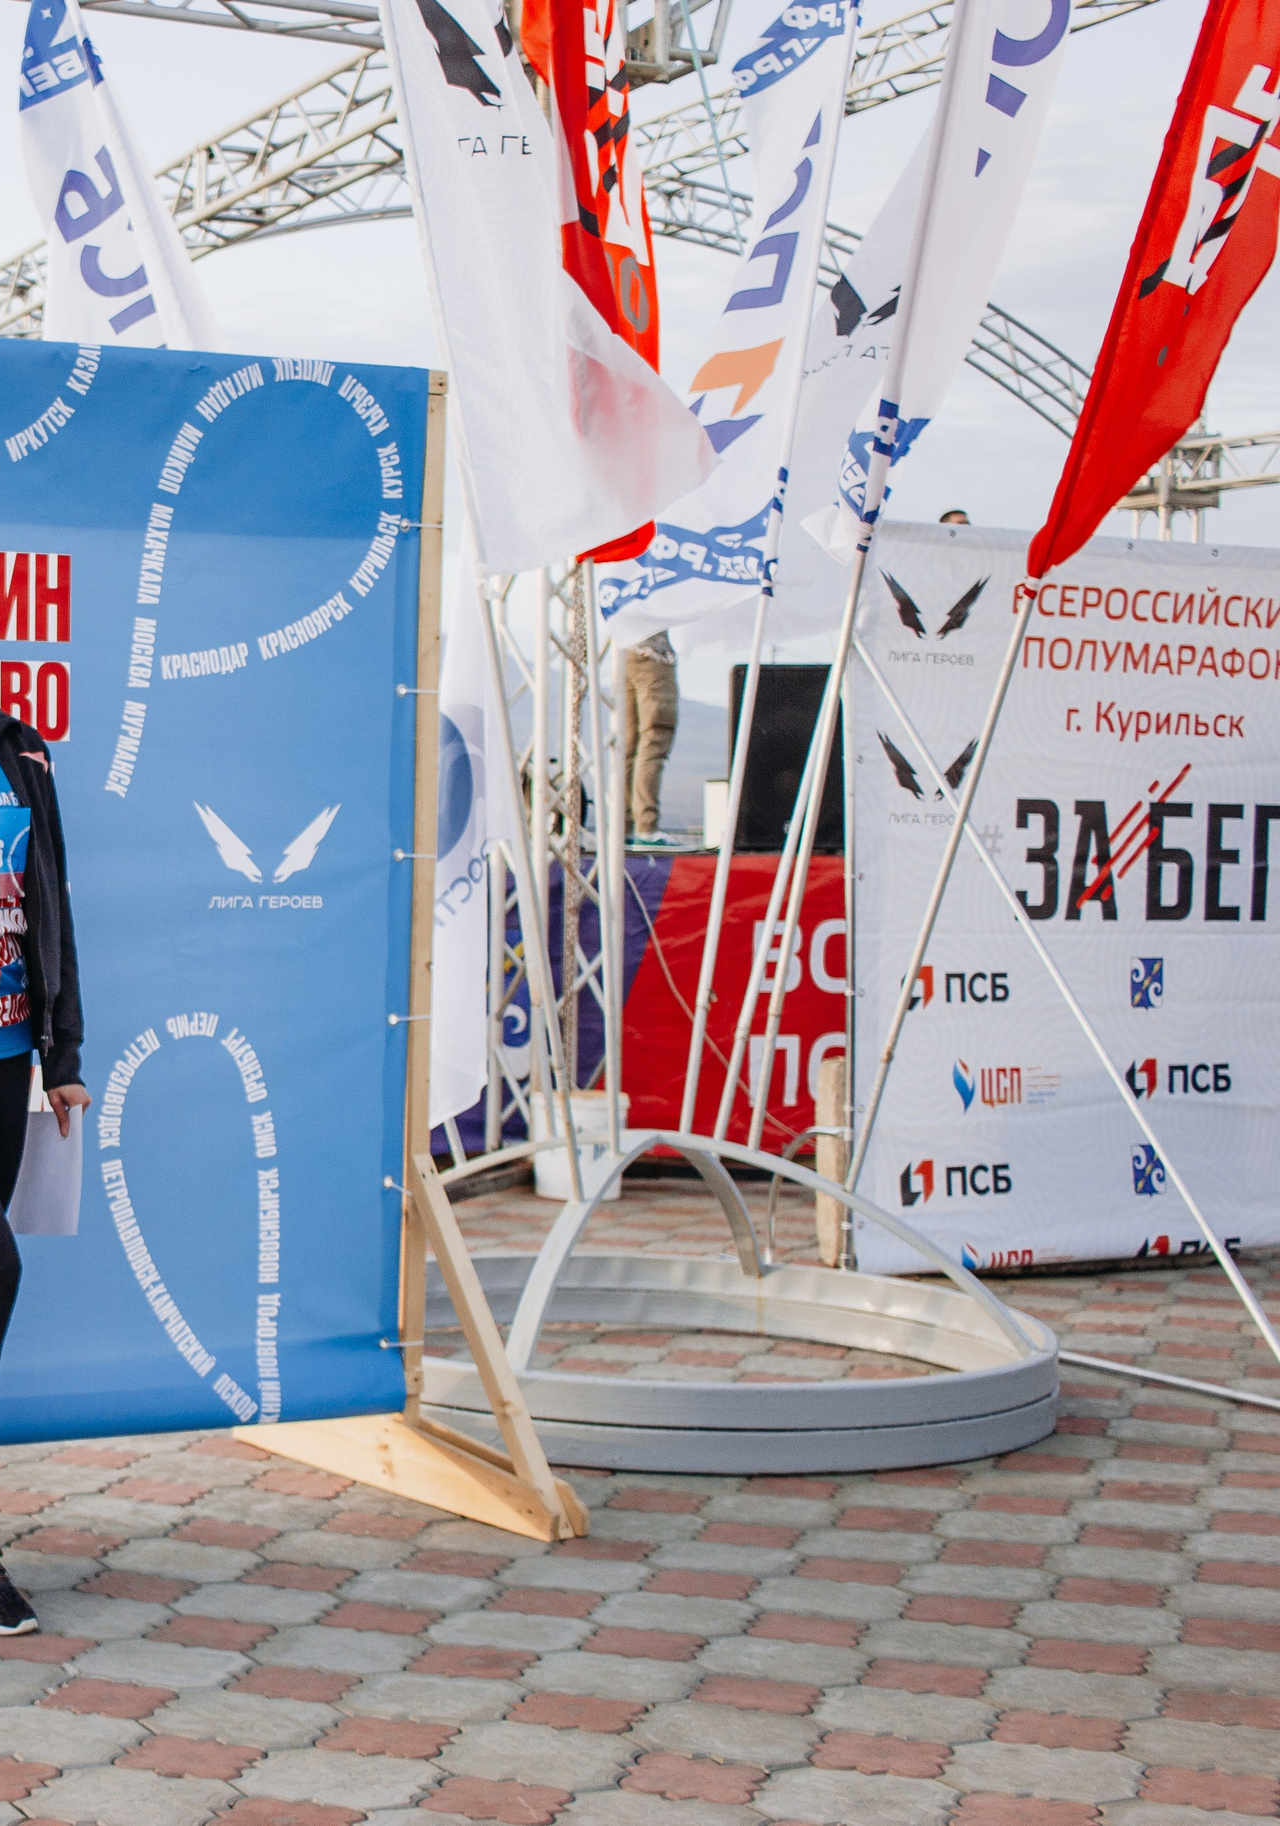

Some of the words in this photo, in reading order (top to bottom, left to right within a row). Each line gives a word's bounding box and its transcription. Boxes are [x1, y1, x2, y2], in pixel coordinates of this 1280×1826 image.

[195, 362, 265, 424] МАГАДАН
[338, 374, 391, 437] КЫЗЫЛ
[5, 396, 76, 463] ИРКУТСК
[158, 421, 204, 495] МАЙКОП
[376, 442, 404, 499] КУРСК
[136, 502, 175, 606] МАХАЧКАЛА
[348, 510, 402, 598] КУРИЛЬСК
[127, 617, 158, 689] МОСКВА
[257, 591, 353, 661] КРАСНОЯРСК
[160, 641, 250, 680] КРАСНОДАР
[887, 650, 921, 665] ЛИГА
[925, 652, 975, 667] ГЕРОЕВ
[104, 700, 147, 798] МУРМАНСК
[1065, 706, 1082, 733] г.
[1096, 701, 1245, 742] Курильск
[209, 895, 253, 910] ЛИГА
[259, 895, 323, 910] ГЕРОЕВ
[945, 973, 1010, 1003] ПСБ
[165, 1011, 219, 1040] ПЕРМЬ
[99, 1028, 161, 1150] ПЕТРОЗАВОДСК
[221, 1027, 268, 1103] ОРЕНБУРГ
[980, 1067, 1022, 1108] ЦСП
[1167, 1063, 1232, 1094] ПСБ
[251, 1110, 277, 1159] ОМСК
[946, 1164, 1012, 1197] ПСБ
[258, 1167, 280, 1284] НОВОСИБИРСК
[101, 1159, 217, 1378] ПЕТРОПАВЛОВСК-КАМЧАТСКИЙ
[257, 1293, 281, 1378] НОВГОРОД
[213, 1372, 259, 1422] ПСКОВ
